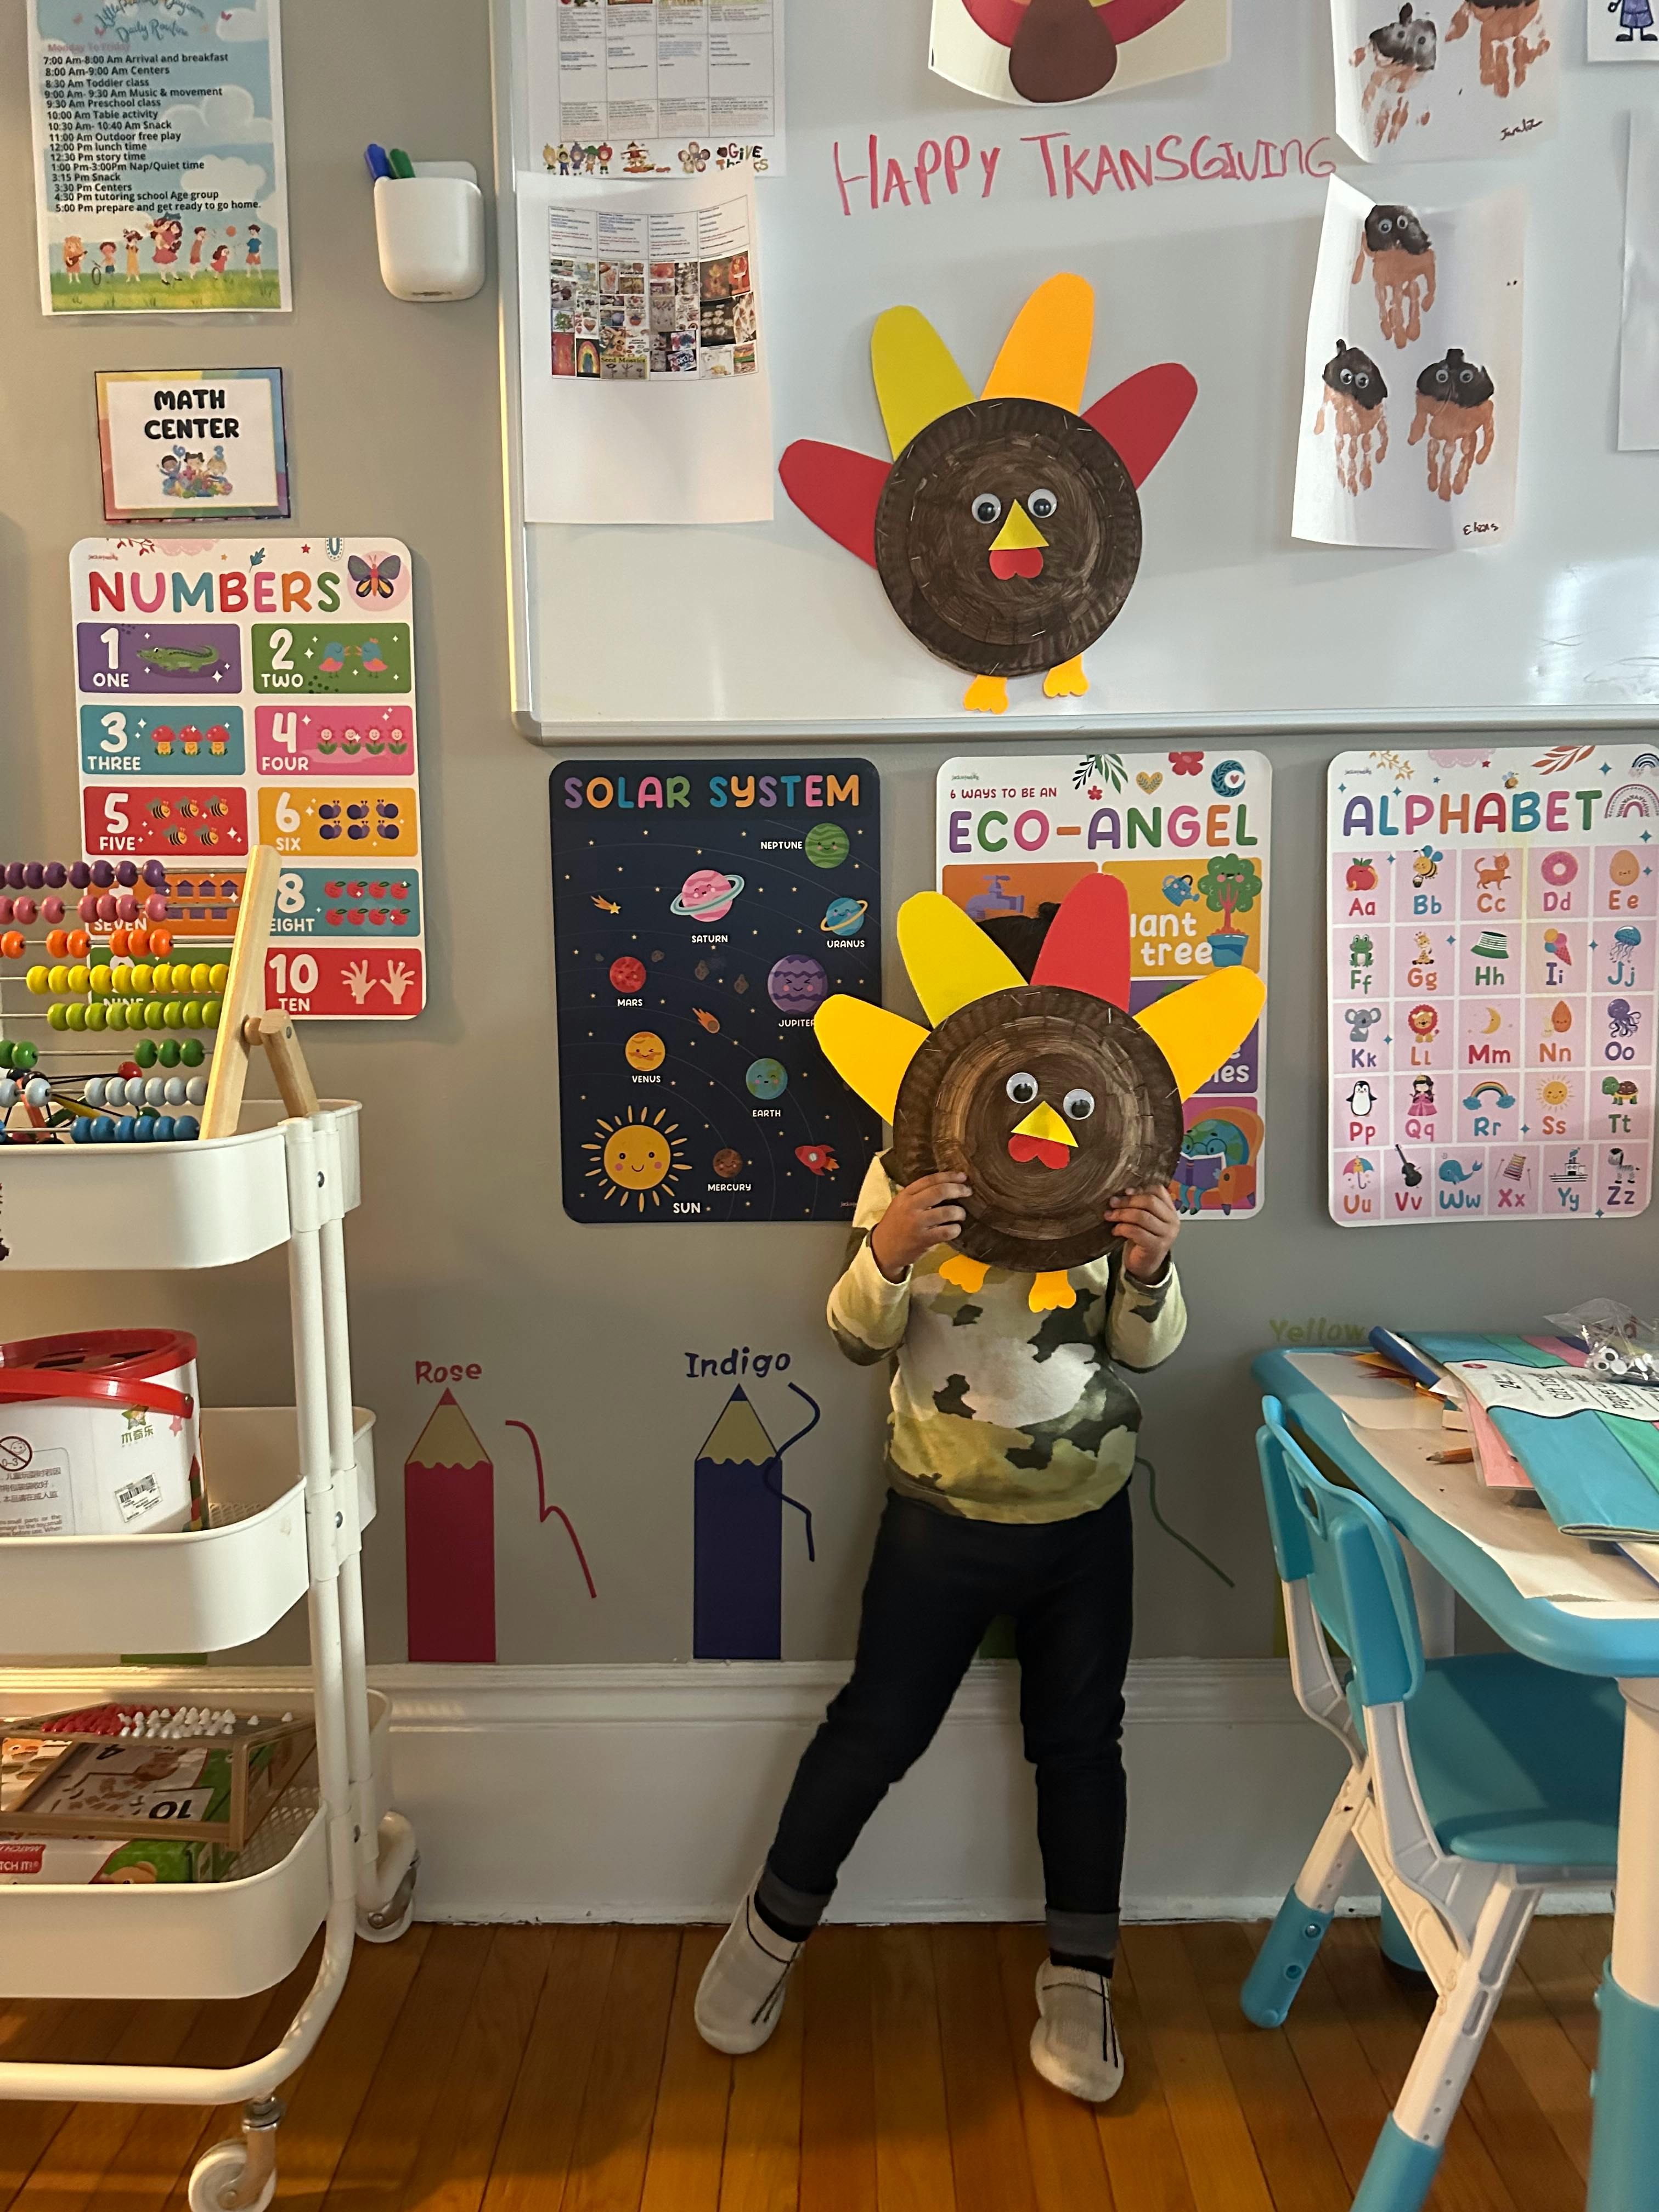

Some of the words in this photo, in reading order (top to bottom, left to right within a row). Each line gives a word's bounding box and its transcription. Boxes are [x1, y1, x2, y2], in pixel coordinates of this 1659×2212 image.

[43, 57, 63, 65] 7:00
[126, 54, 158, 63] Arrival
[161, 54, 179, 63] and
[182, 53, 228, 62] breakfast
[46, 67, 65, 76] 8:00
[131, 66, 170, 75] Centers
[86, 78, 122, 87] Toddler
[126, 78, 149, 86] class
[110, 89, 126, 97] Am
[129, 88, 157, 97] Music
[160, 88, 167, 97] &
[170, 88, 223, 97] movement
[47, 100, 66, 108] 9:30
[88, 99, 135, 108] Preschool
[138, 98, 161, 106] class
[93, 110, 120, 119] Table
[122, 110, 158, 120] activity
[48, 122, 72, 131] 10:30
[125, 121, 140, 129] Am
[143, 120, 172, 129] Snack
[95, 133, 136, 141] Outdoor
[139, 132, 158, 140] free
[161, 132, 181, 142] play
[95, 143, 122, 151] lunch
[96, 154, 121, 162] story
[129, 161, 179, 172] Nap/Quiet
[182, 161, 205, 170] time
[92, 173, 121, 181] Snack
[834, 134, 1001, 216] HAPPY
[95, 193, 135, 202] tutoring
[138, 191, 168, 200] school
[171, 192, 191, 201] Age
[190, 191, 219, 201] group
[96, 205, 134, 213] prepare
[137, 203, 154, 211] and
[157, 204, 172, 213] get
[175, 202, 202, 212] ready
[217, 202, 228, 211] go
[154, 390, 225, 410] MATH
[144, 418, 239, 439] CENTER
[89, 571, 340, 613] NUMBERS
[100, 628, 119, 669] 1
[269, 628, 294, 670] 2
[93, 673, 129, 687] ONE
[261, 673, 303, 687] TWO
[100, 712, 128, 753] 3
[272, 712, 297, 753] 4
[88, 756, 141, 770] THREE
[262, 757, 309, 771] FOUR
[564, 776, 691, 809] SOLAR
[709, 775, 859, 808] SYSTEM
[950, 789, 956, 799] 6
[962, 789, 996, 799] WAYS
[1002, 788, 1017, 798] TO
[1022, 788, 1035, 798] BE
[1040, 787, 1057, 797] AN
[104, 793, 129, 834] 5
[276, 792, 300, 833] 6
[1343, 790, 1602, 837] ALPHABET
[949, 804, 1257, 854] ECO-ANGEL
[100, 837, 136, 850] FIVE
[276, 837, 301, 851] SIX
[760, 841, 803, 850] NEPTUNE
[278, 873, 305, 913] 8
[1477, 893, 1506, 913] Cc
[1543, 891, 1571, 911] Dd
[1609, 890, 1639, 910] Ee
[1348, 898, 1375, 916] Aa
[1413, 894, 1442, 915] Bb
[94, 918, 147, 931] SEVEN
[270, 918, 315, 932] EIGHT
[1130, 912, 1197, 938] lant
[691, 934, 729, 943] SATURN
[827, 940, 865, 948] URANUS
[1141, 941, 1212, 966] tree
[269, 953, 319, 994] 10
[1351, 969, 1372, 994] Ff
[1407, 967, 1437, 991] Gg
[1475, 966, 1505, 986] Hh
[1545, 962, 1563, 985] Ii
[1607, 961, 1635, 987] Jj
[279, 998, 310, 1012] TEN
[617, 998, 643, 1007] MARS
[1351, 1048, 1377, 1068] Kk
[1468, 1044, 1510, 1064] Mm
[1539, 1043, 1571, 1063] Nn
[1605, 1041, 1635, 1061] Oo
[631, 1075, 661, 1084] VENUS
[1350, 1121, 1375, 1145] Pp
[1405, 1119, 1435, 1142] Qq
[1474, 1116, 1501, 1136] Rr
[1542, 1116, 1566, 1135] Ss
[1608, 1114, 1631, 1133] Tt
[708, 1183, 752, 1192] MERCURY
[1498, 1188, 1525, 1207] Xx
[1607, 1186, 1635, 1205] Zz
[673, 1203, 701, 1214] SUN
[1344, 1194, 1372, 1214] Uu
[1395, 1192, 1423, 1211] Vv
[1439, 1189, 1481, 1210] Ww
[1558, 1187, 1579, 1212] Yy
[1269, 1317, 1365, 1342] Yellow
[684, 1346, 791, 1378] Indigo
[415, 1360, 483, 1385] Rose
